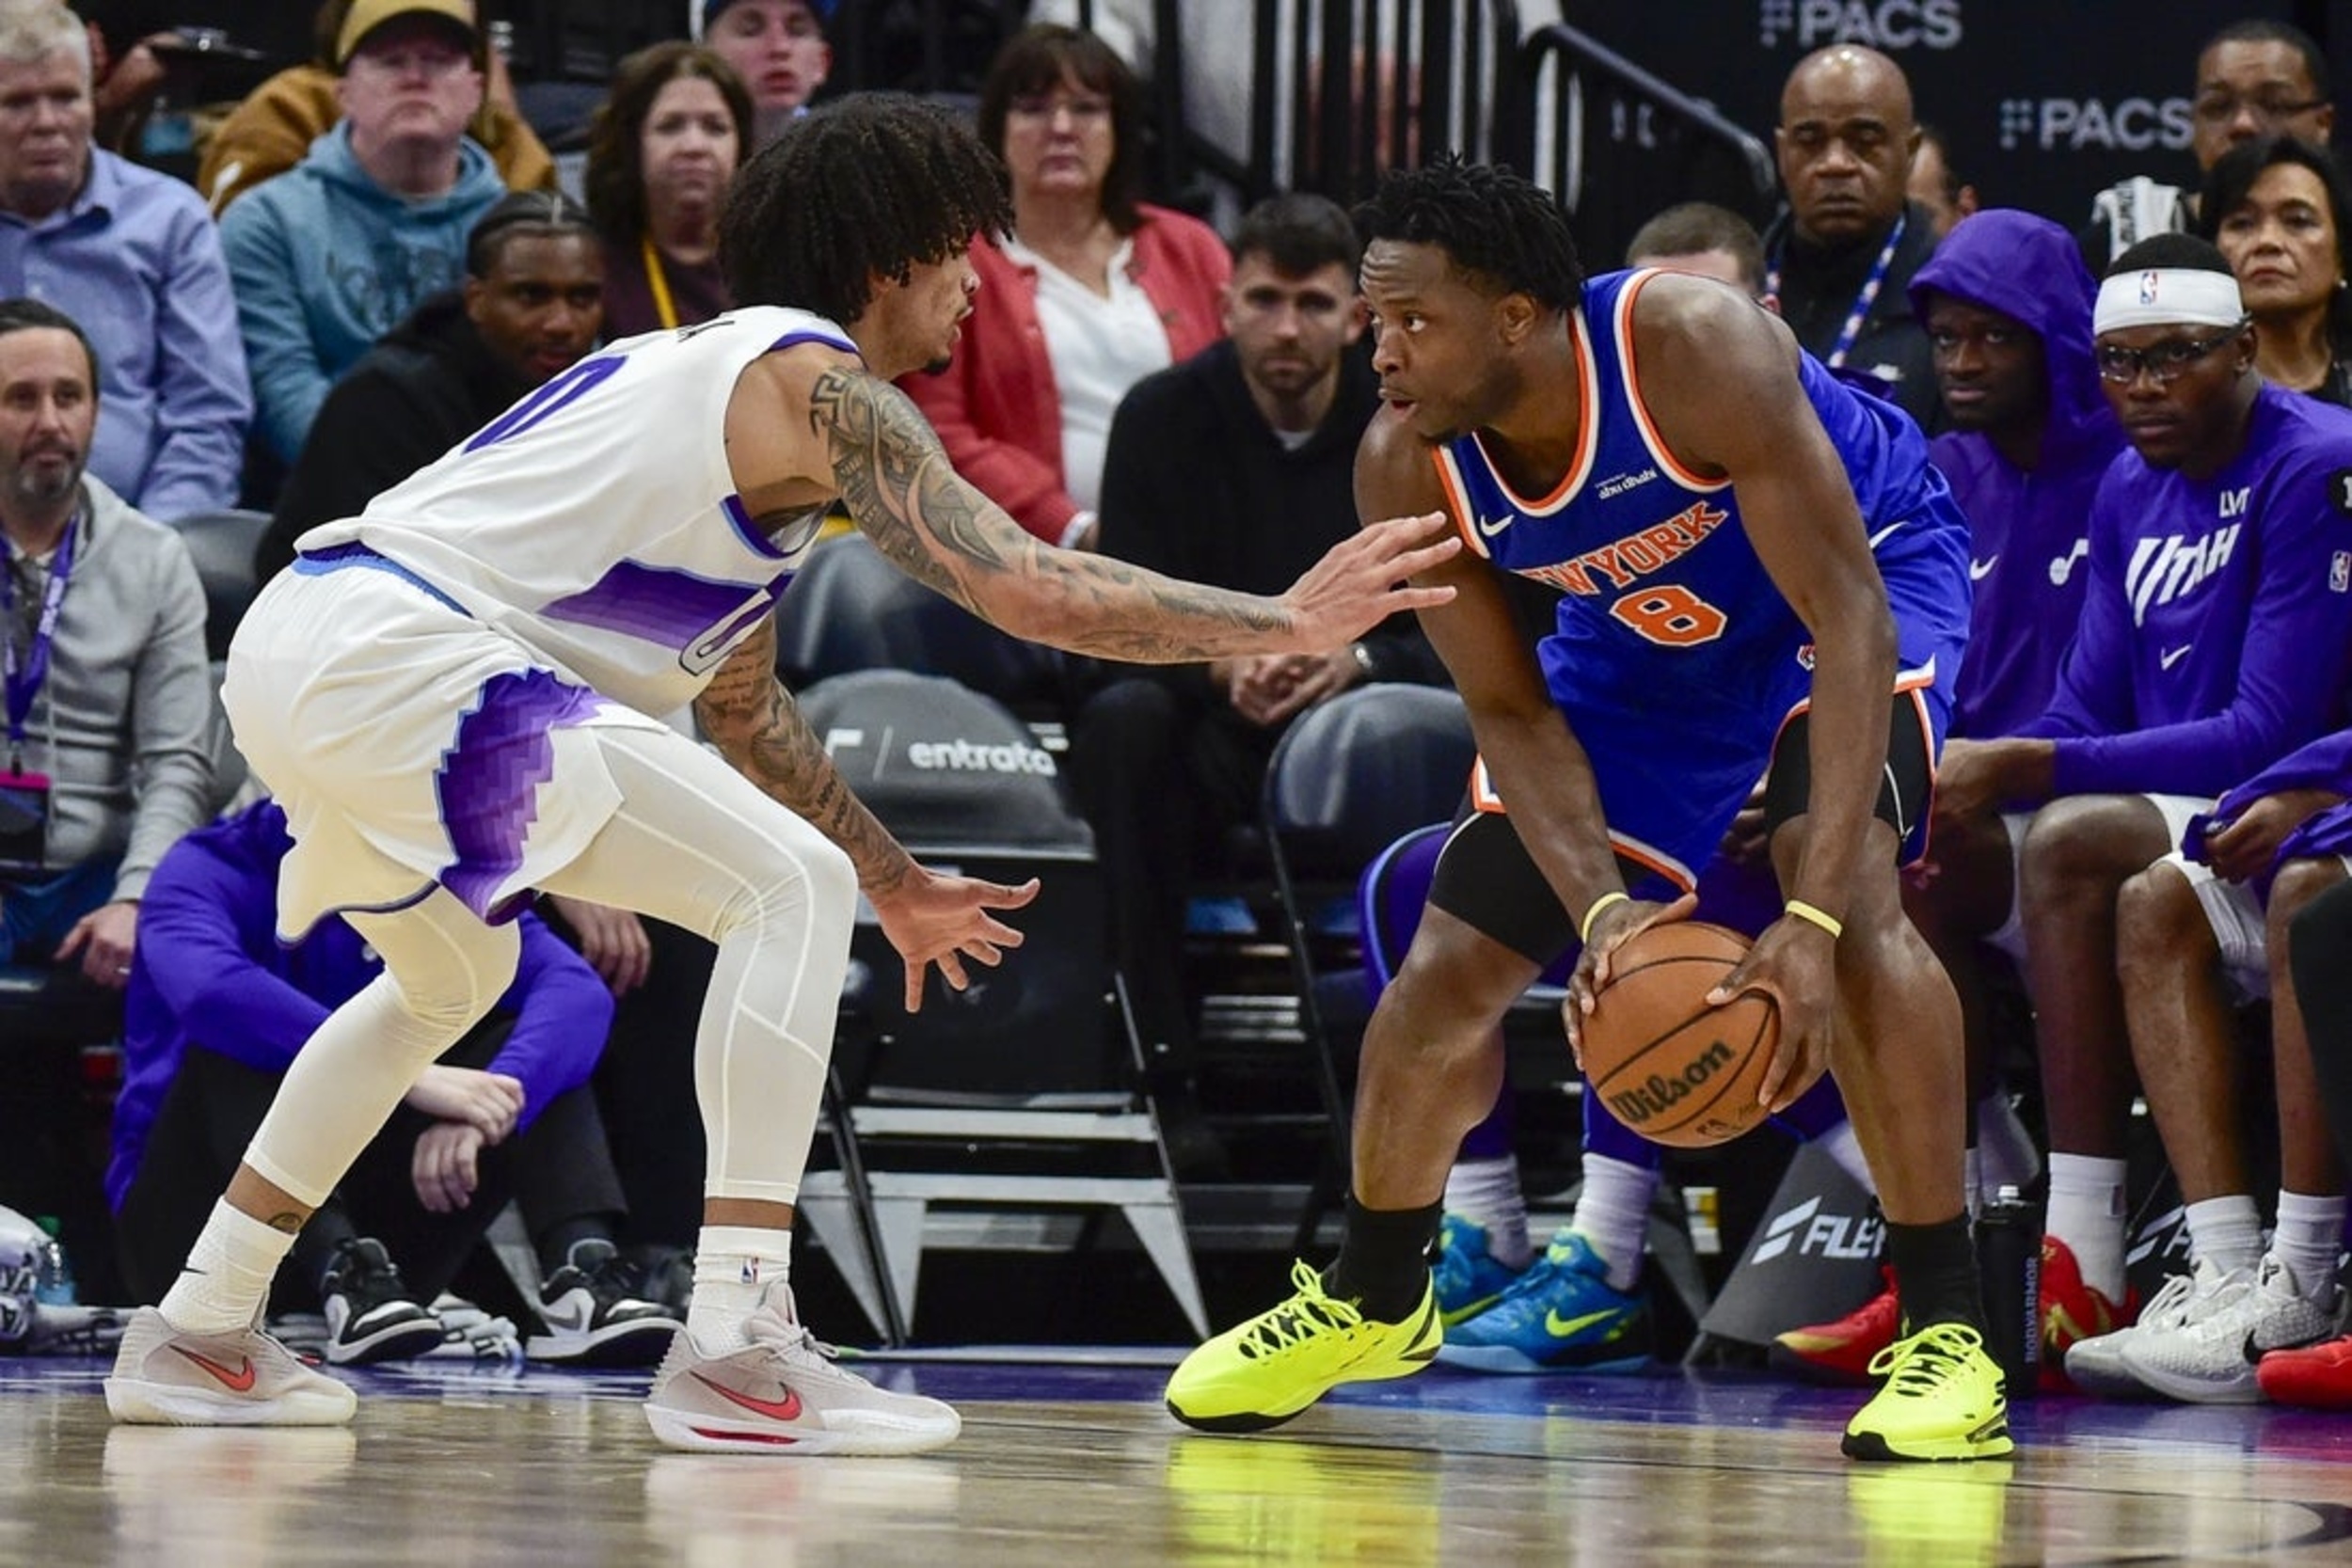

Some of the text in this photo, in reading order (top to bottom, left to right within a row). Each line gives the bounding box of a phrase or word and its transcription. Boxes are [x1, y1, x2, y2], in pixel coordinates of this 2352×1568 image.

[1799, 0, 1963, 47] PACS
[2039, 97, 2196, 150] PACS
[1581, 499, 1729, 590] YORK
[2124, 523, 2241, 628] UTAH
[1609, 583, 1728, 646] 8
[908, 738, 1057, 777] entrata
[1608, 1039, 1736, 1124] Wilson
